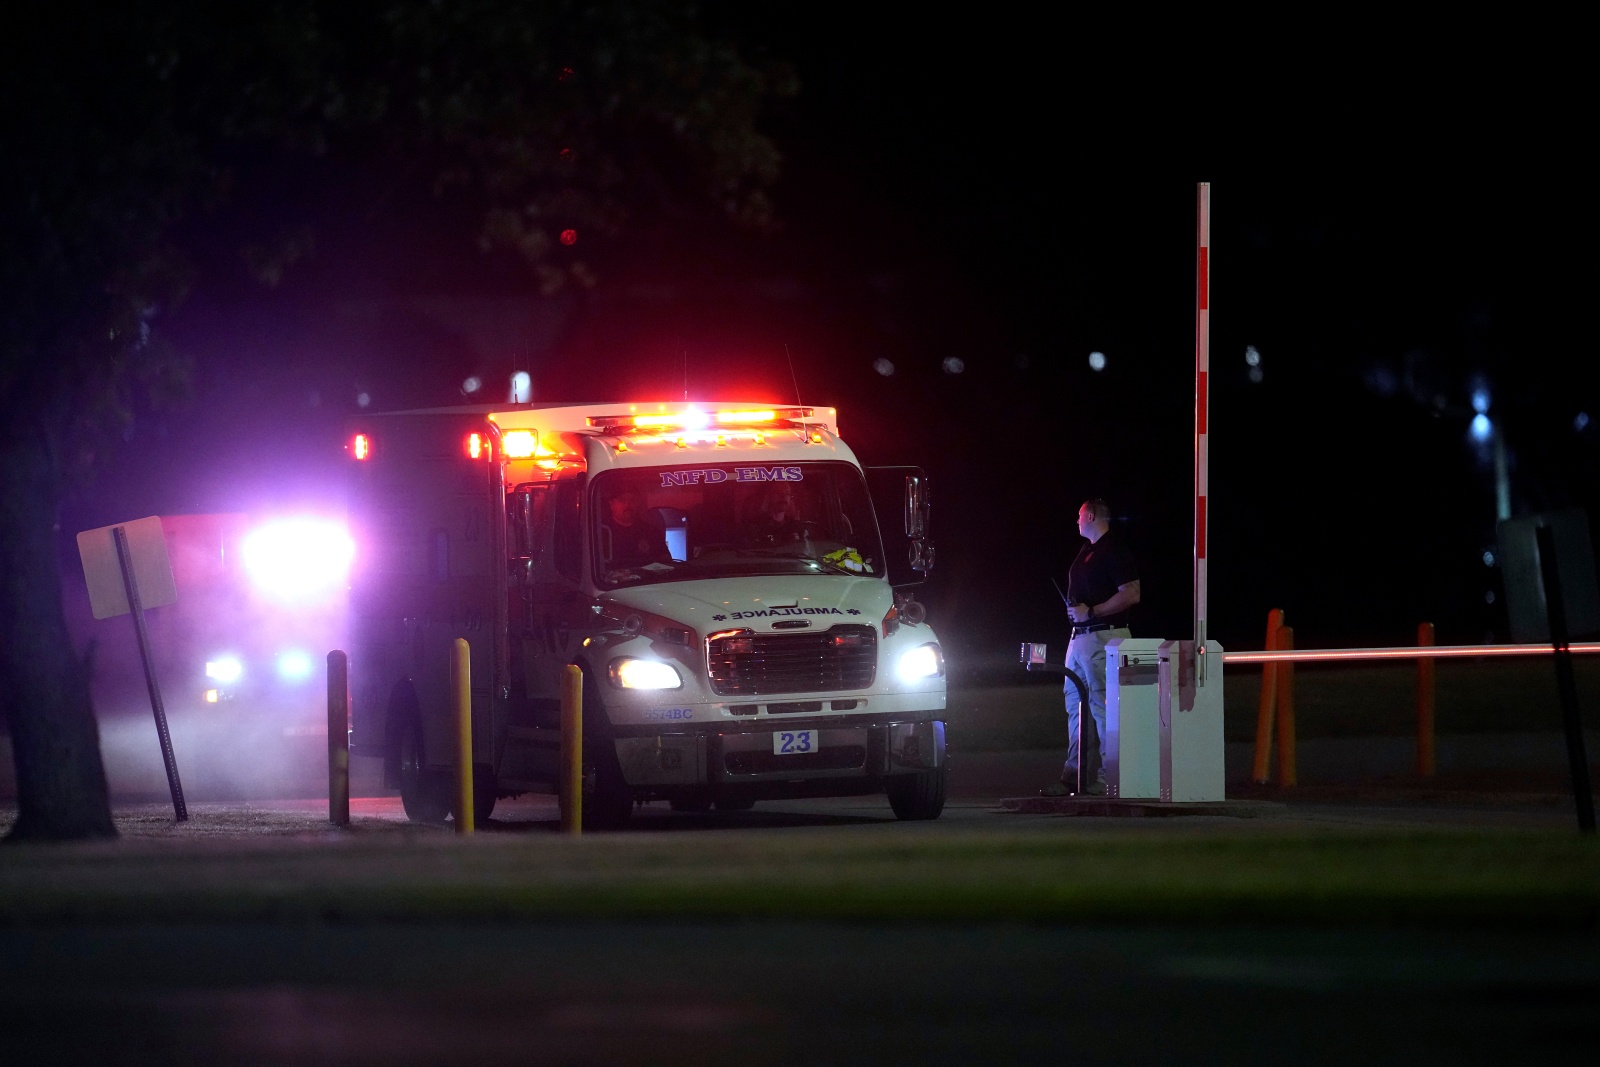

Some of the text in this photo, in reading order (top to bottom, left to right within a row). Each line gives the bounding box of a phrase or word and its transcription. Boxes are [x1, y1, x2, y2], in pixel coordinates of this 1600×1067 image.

[658, 465, 804, 487] NFD EMS
[780, 732, 811, 752] 23
